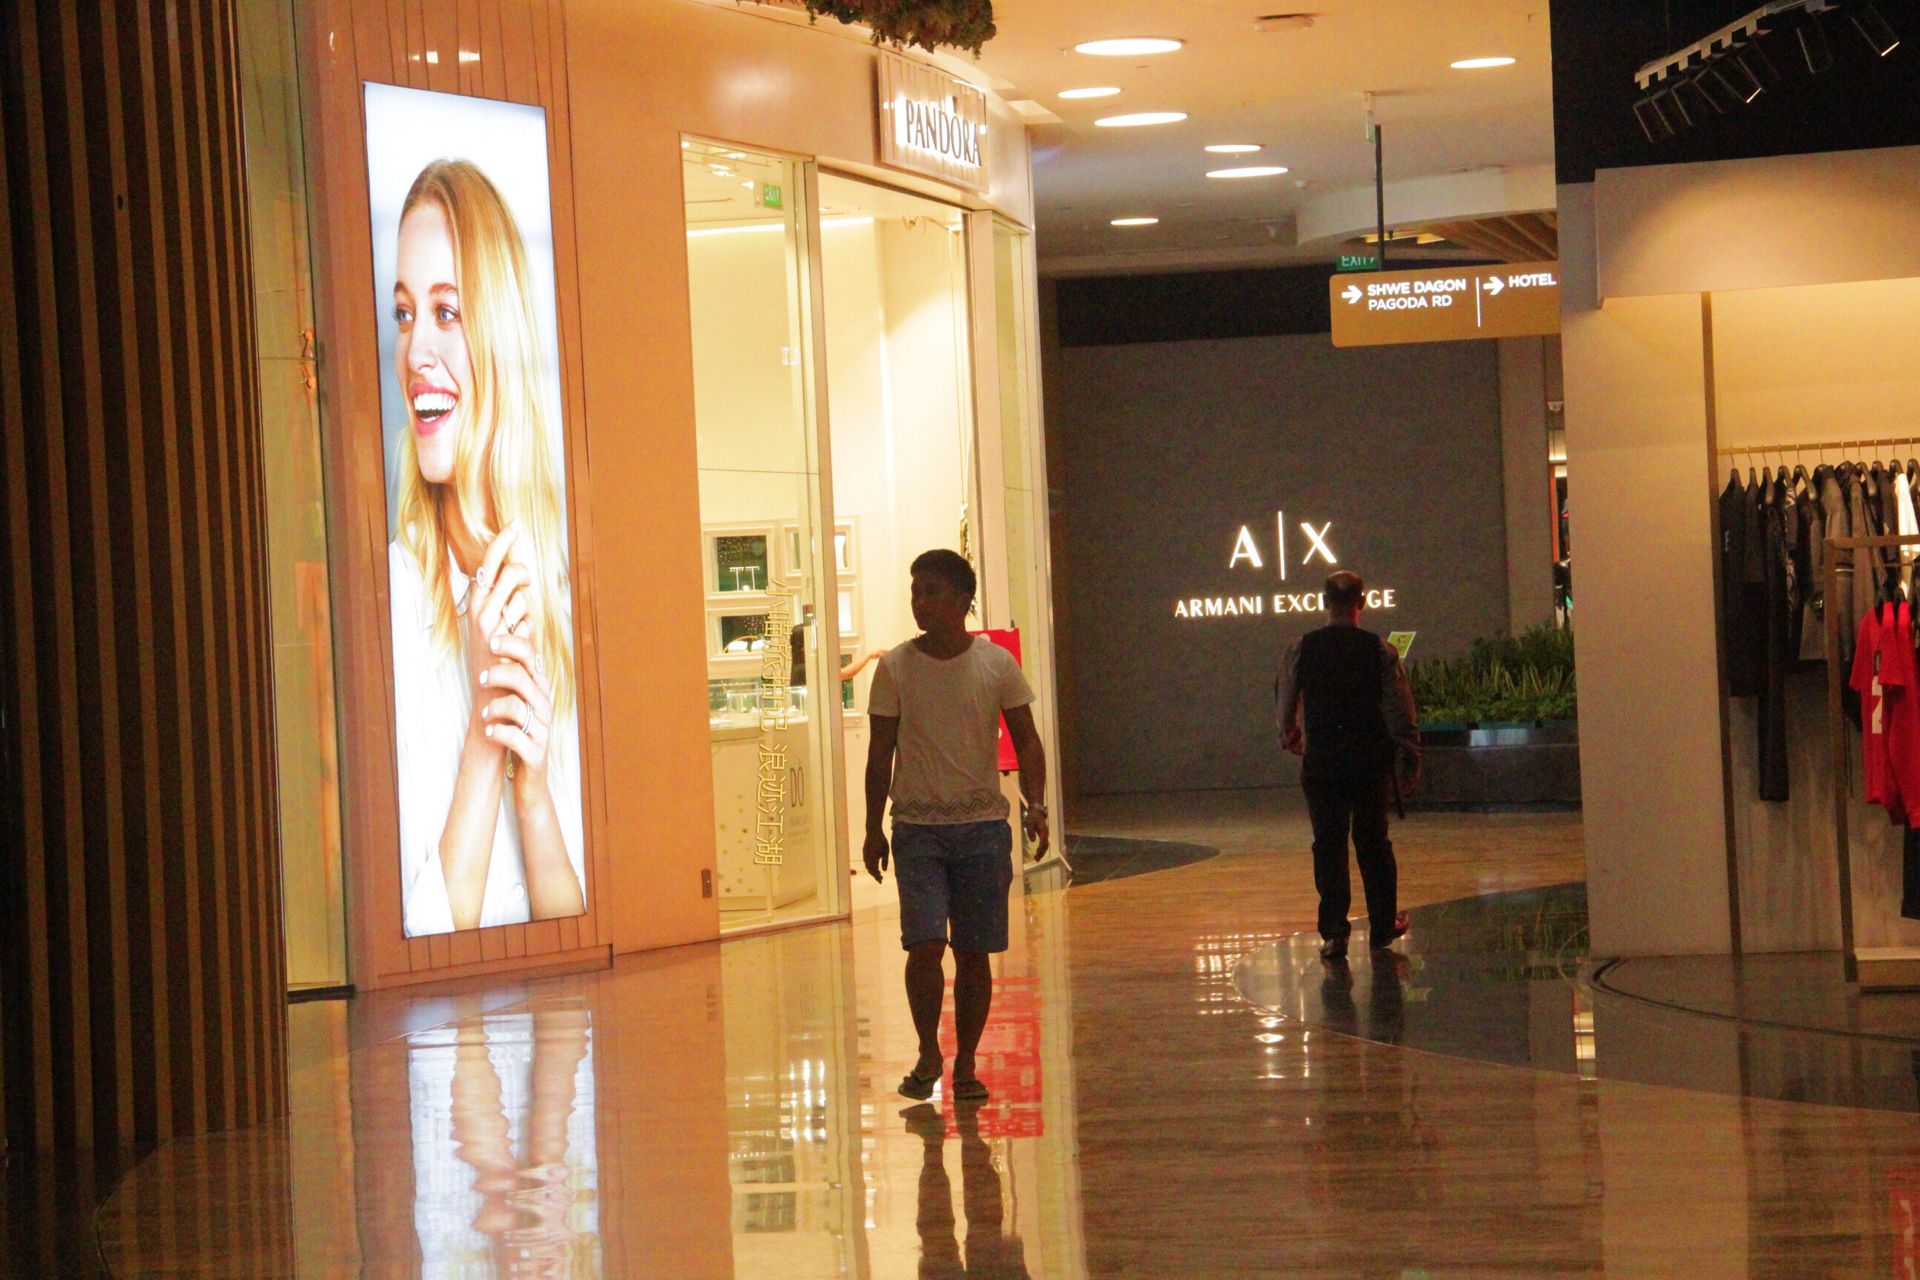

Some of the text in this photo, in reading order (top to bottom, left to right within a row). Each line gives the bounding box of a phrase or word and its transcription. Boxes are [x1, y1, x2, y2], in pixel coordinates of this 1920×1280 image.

[905, 99, 982, 166] PANDORA
[1367, 278, 1467, 296] SHWE DAGON
[1508, 273, 1557, 288] HOTEL
[1368, 294, 1453, 311] PAGODA RD
[1175, 589, 1396, 618] ARMANI EXCGE
